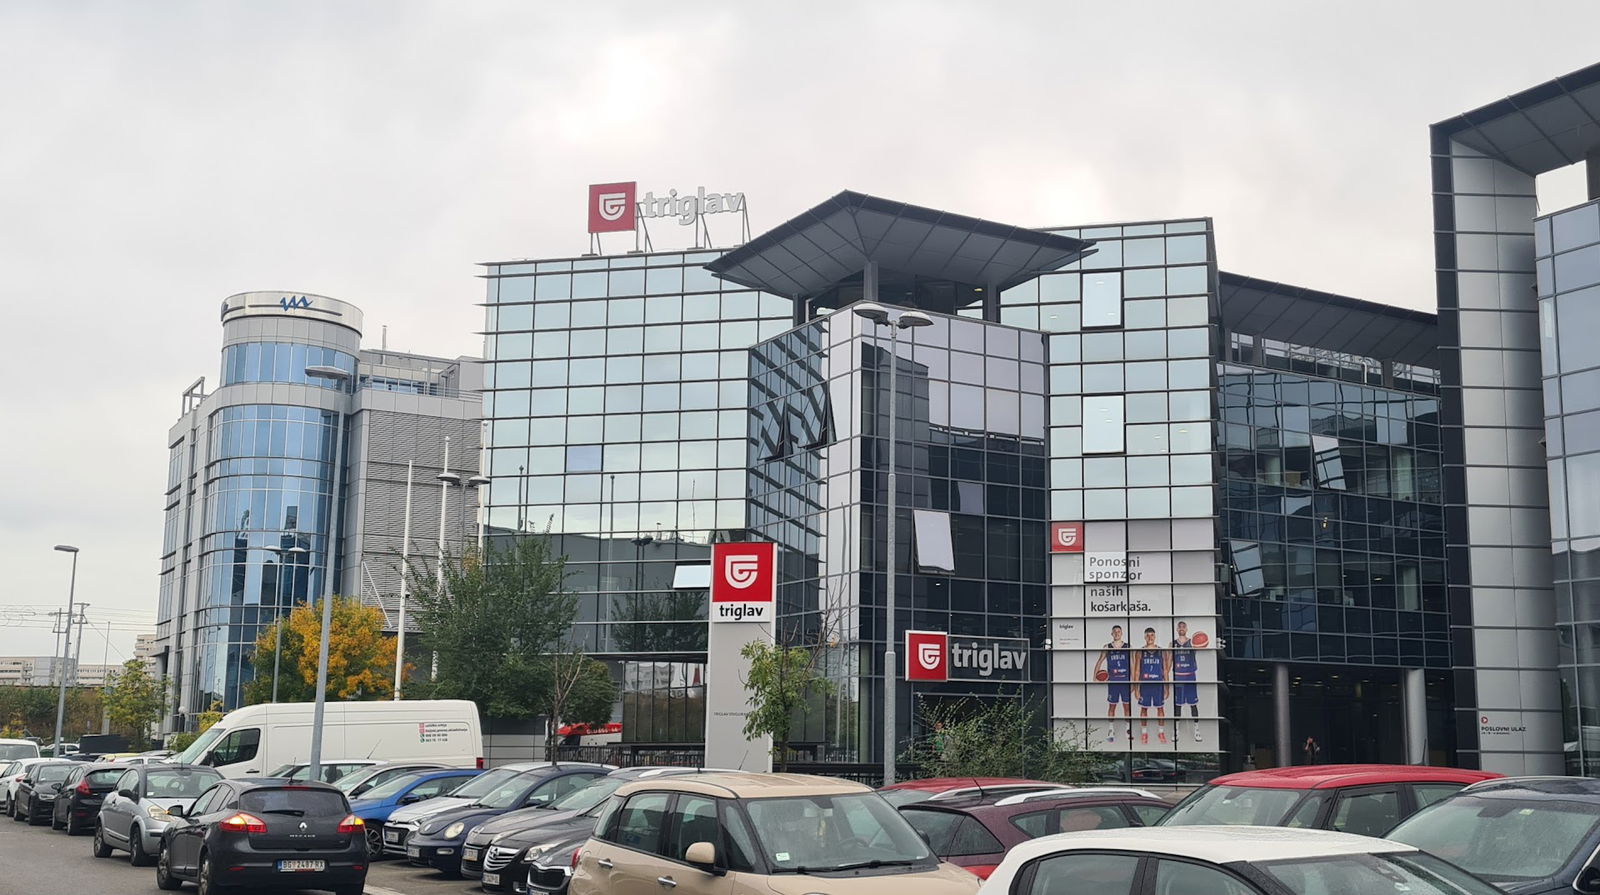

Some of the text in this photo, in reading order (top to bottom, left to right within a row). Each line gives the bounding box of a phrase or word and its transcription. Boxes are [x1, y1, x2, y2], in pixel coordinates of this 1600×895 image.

[643, 186, 744, 226] triglav
[1089, 556, 1140, 568] Ponosni
[1088, 571, 1143, 583] sponzor
[1090, 585, 1124, 597] naših
[719, 603, 764, 621] triglav
[1090, 600, 1152, 612] košarkaša.
[951, 641, 1027, 677] triglav
